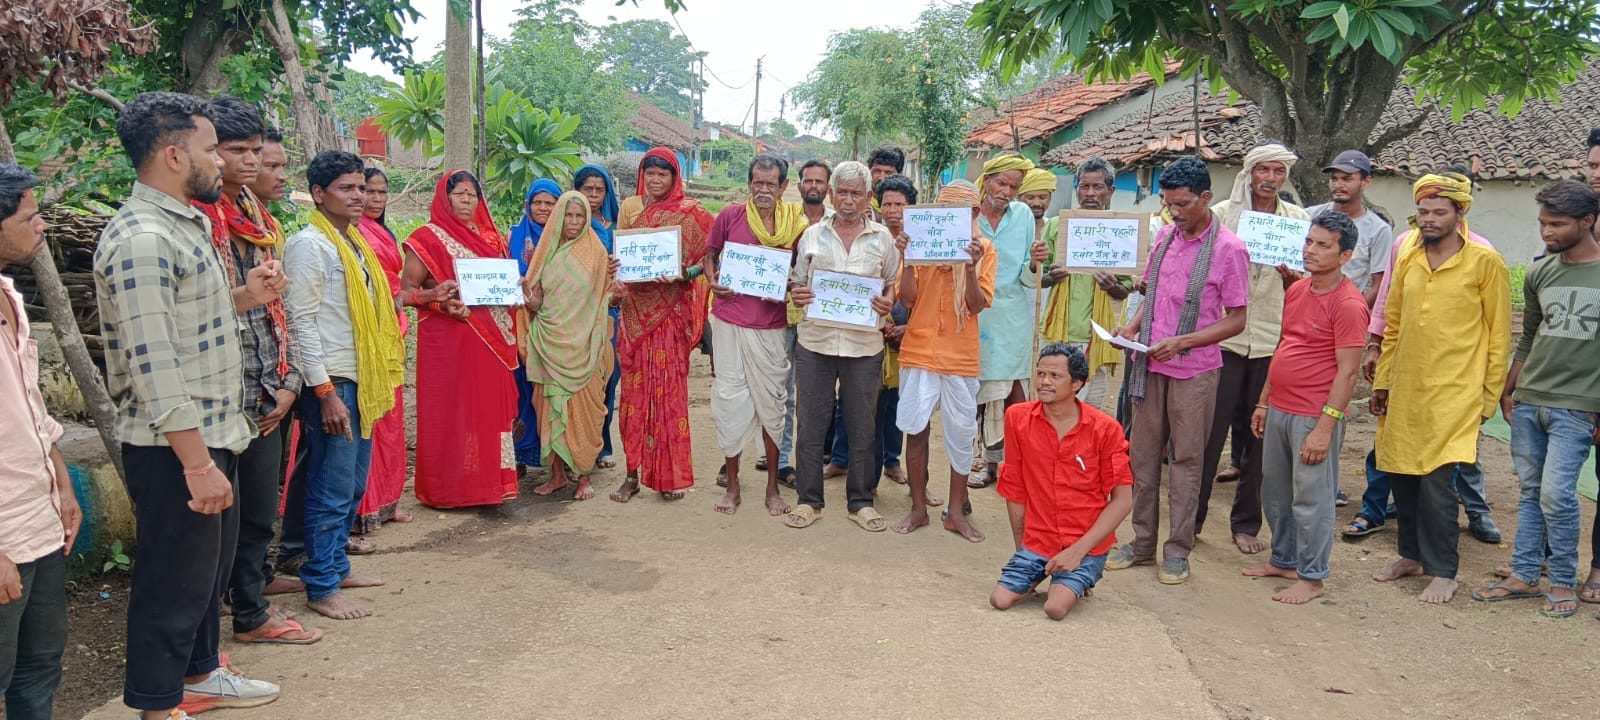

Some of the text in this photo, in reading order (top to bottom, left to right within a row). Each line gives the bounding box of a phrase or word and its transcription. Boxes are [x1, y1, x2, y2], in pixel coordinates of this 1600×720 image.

[726, 249, 754, 265] विकास
[755, 265, 767, 278] तो
[819, 277, 851, 294] हमारी
[817, 297, 845, 315] पूरी
